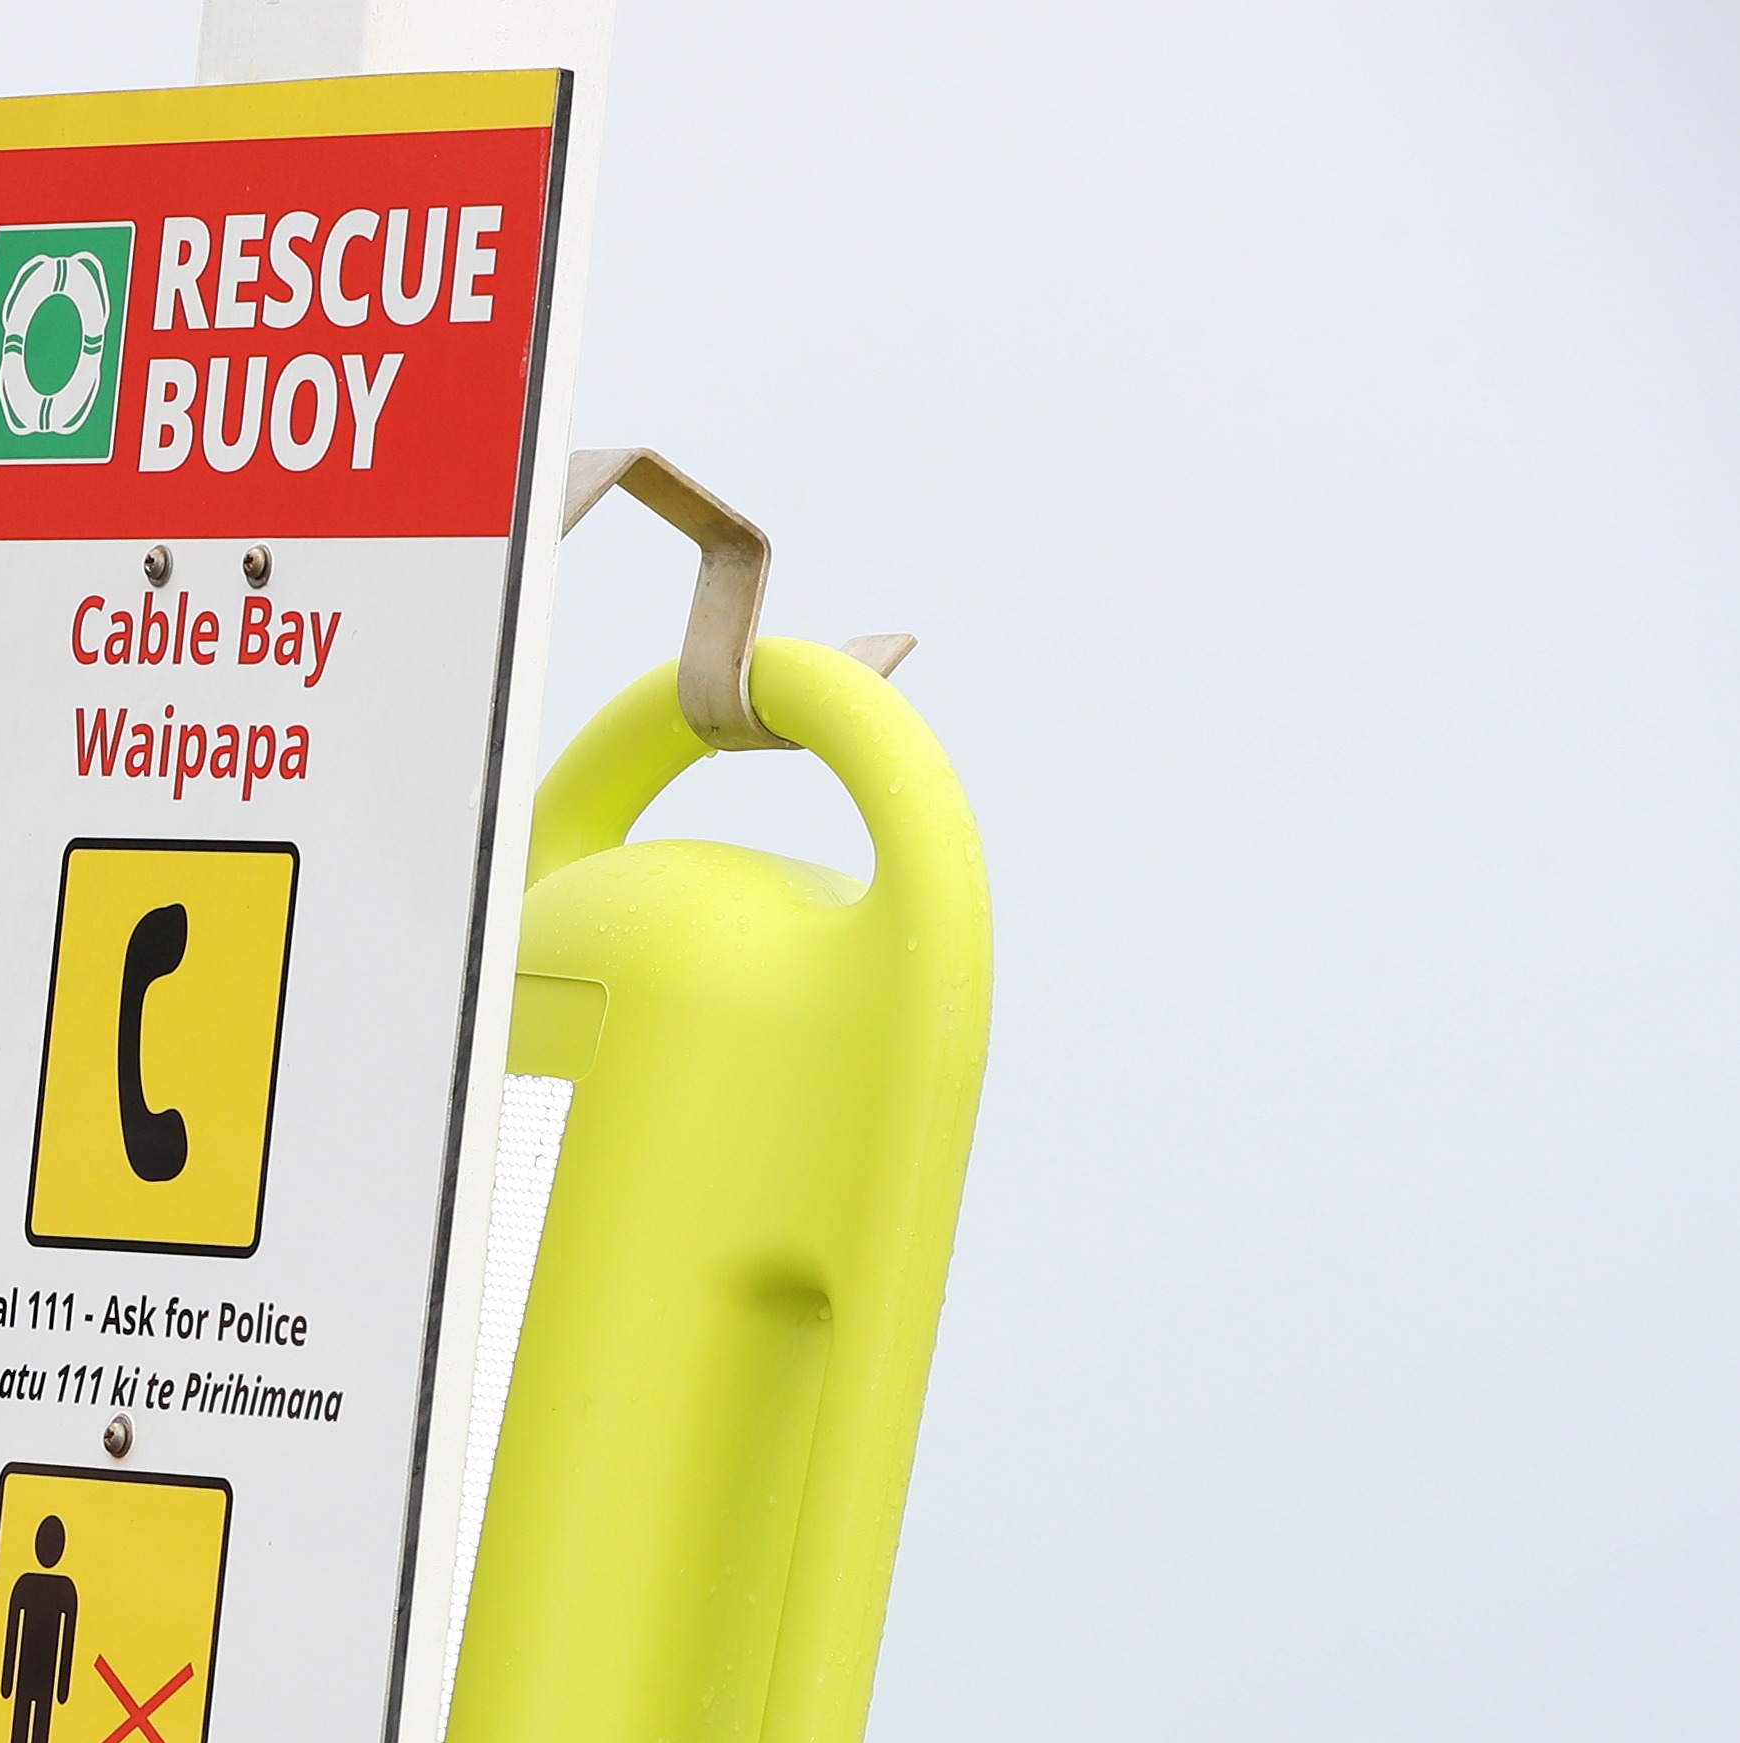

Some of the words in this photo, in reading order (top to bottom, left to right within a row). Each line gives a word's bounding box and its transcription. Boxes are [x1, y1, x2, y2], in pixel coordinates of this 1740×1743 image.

[152, 205, 503, 331] RESCUE
[137, 352, 405, 472] BUOY
[71, 591, 220, 666] Cable
[237, 595, 342, 688] Bay
[75, 704, 310, 802] Waipapa
[28, 1290, 75, 1332] 111
[84, 1313, 94, 1322] -
[100, 1294, 157, 1337] Ask
[165, 1296, 210, 1340] for
[217, 1302, 308, 1347] Police
[57, 1364, 104, 1405] 111
[110, 1365, 141, 1408] ki
[145, 1372, 175, 1411] te
[181, 1371, 344, 1422] Pirihimana
